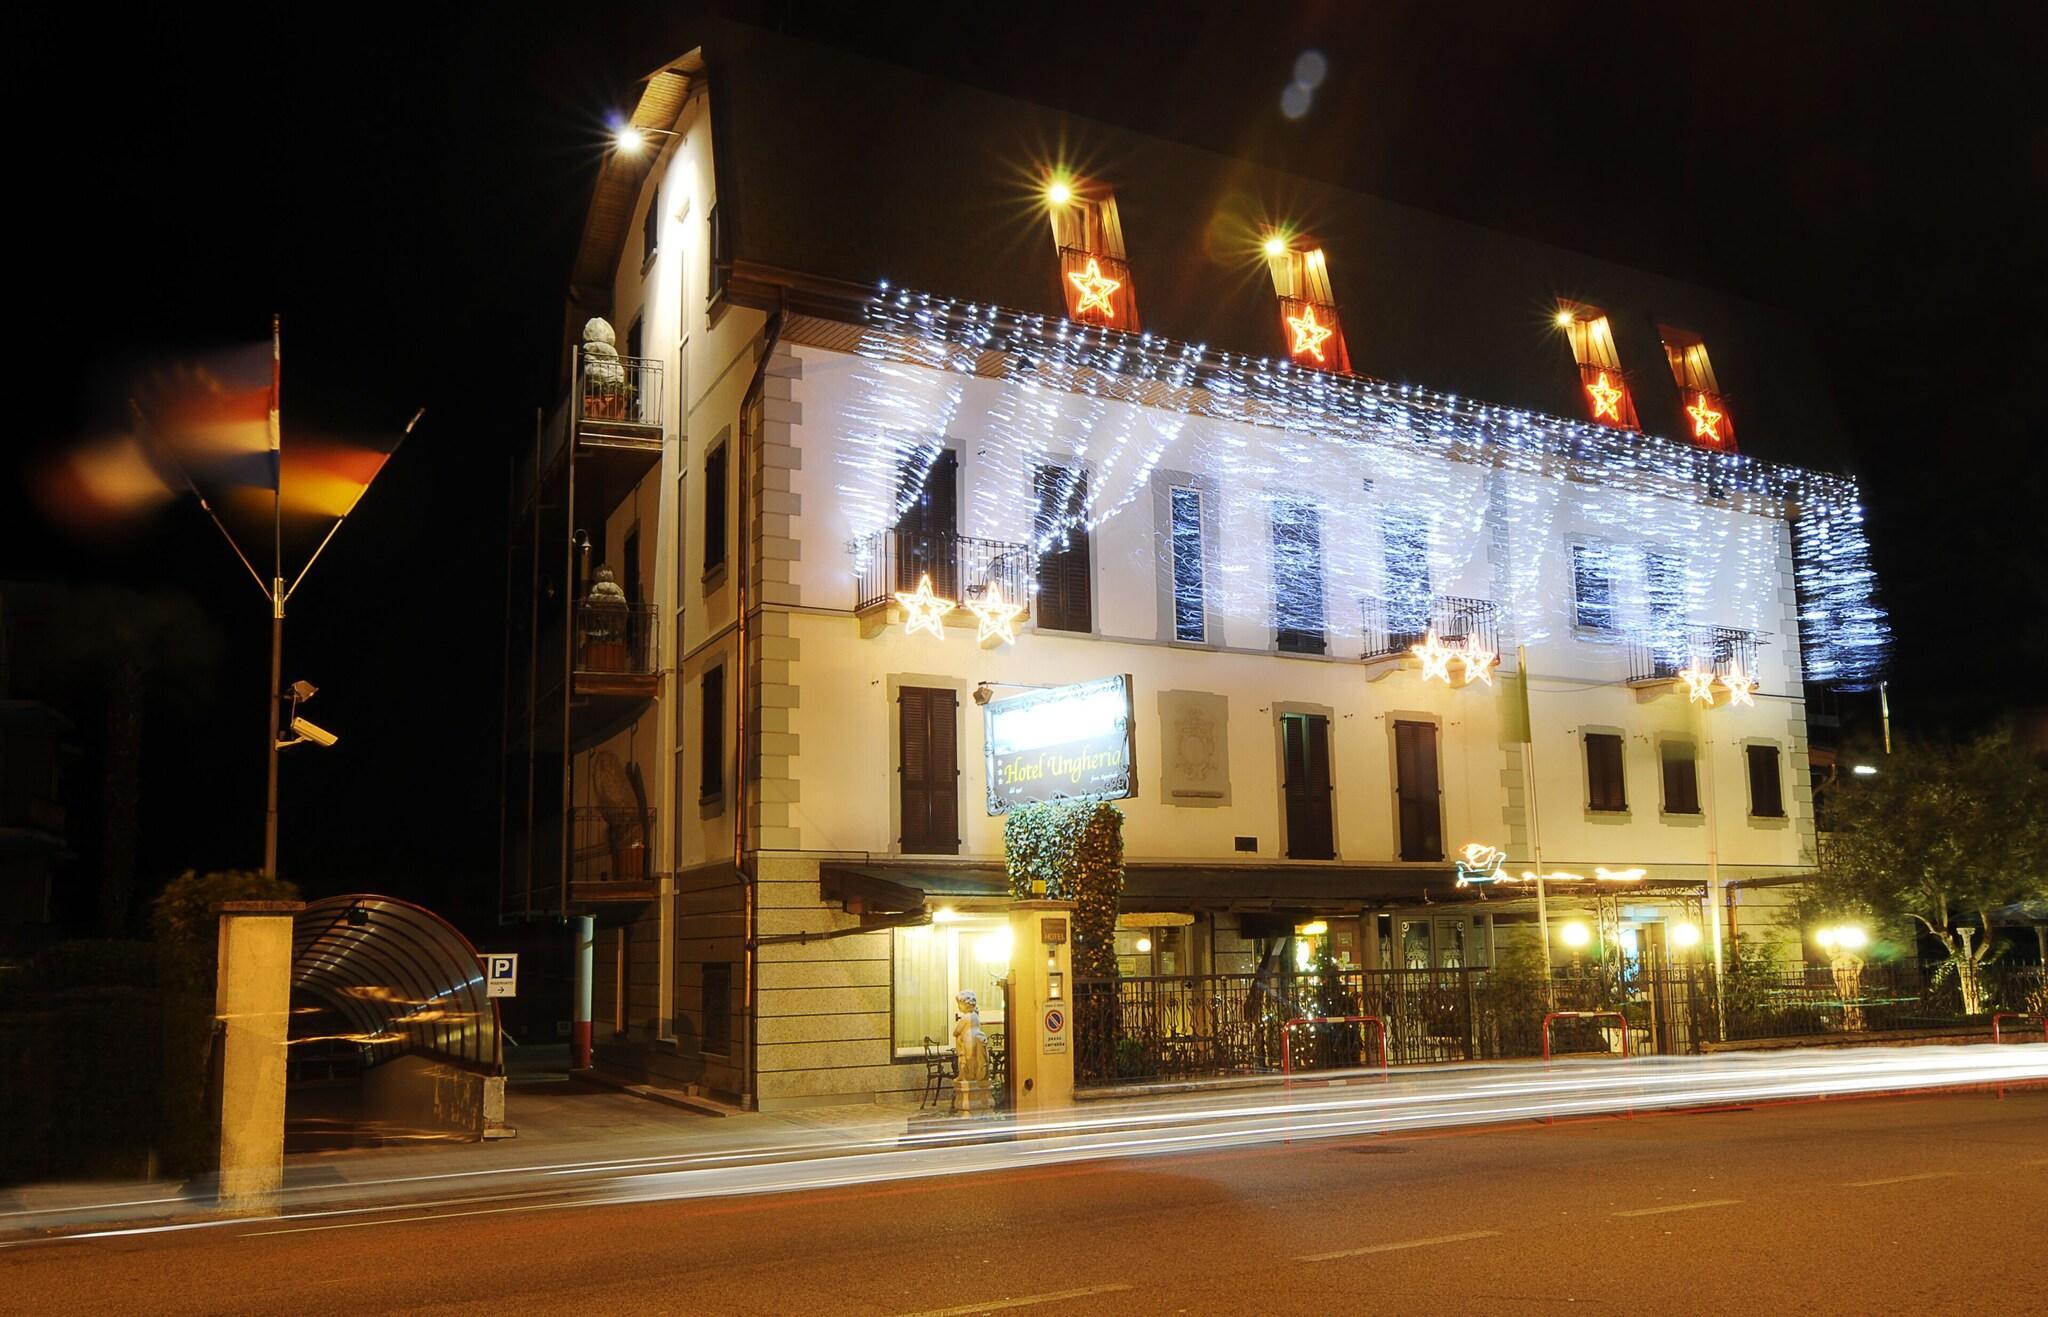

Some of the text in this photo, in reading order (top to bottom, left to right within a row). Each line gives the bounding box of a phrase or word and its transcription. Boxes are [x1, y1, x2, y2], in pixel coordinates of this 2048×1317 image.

[1004, 745, 1121, 785] Hotel Ungheria
[496, 960, 510, 977] P
